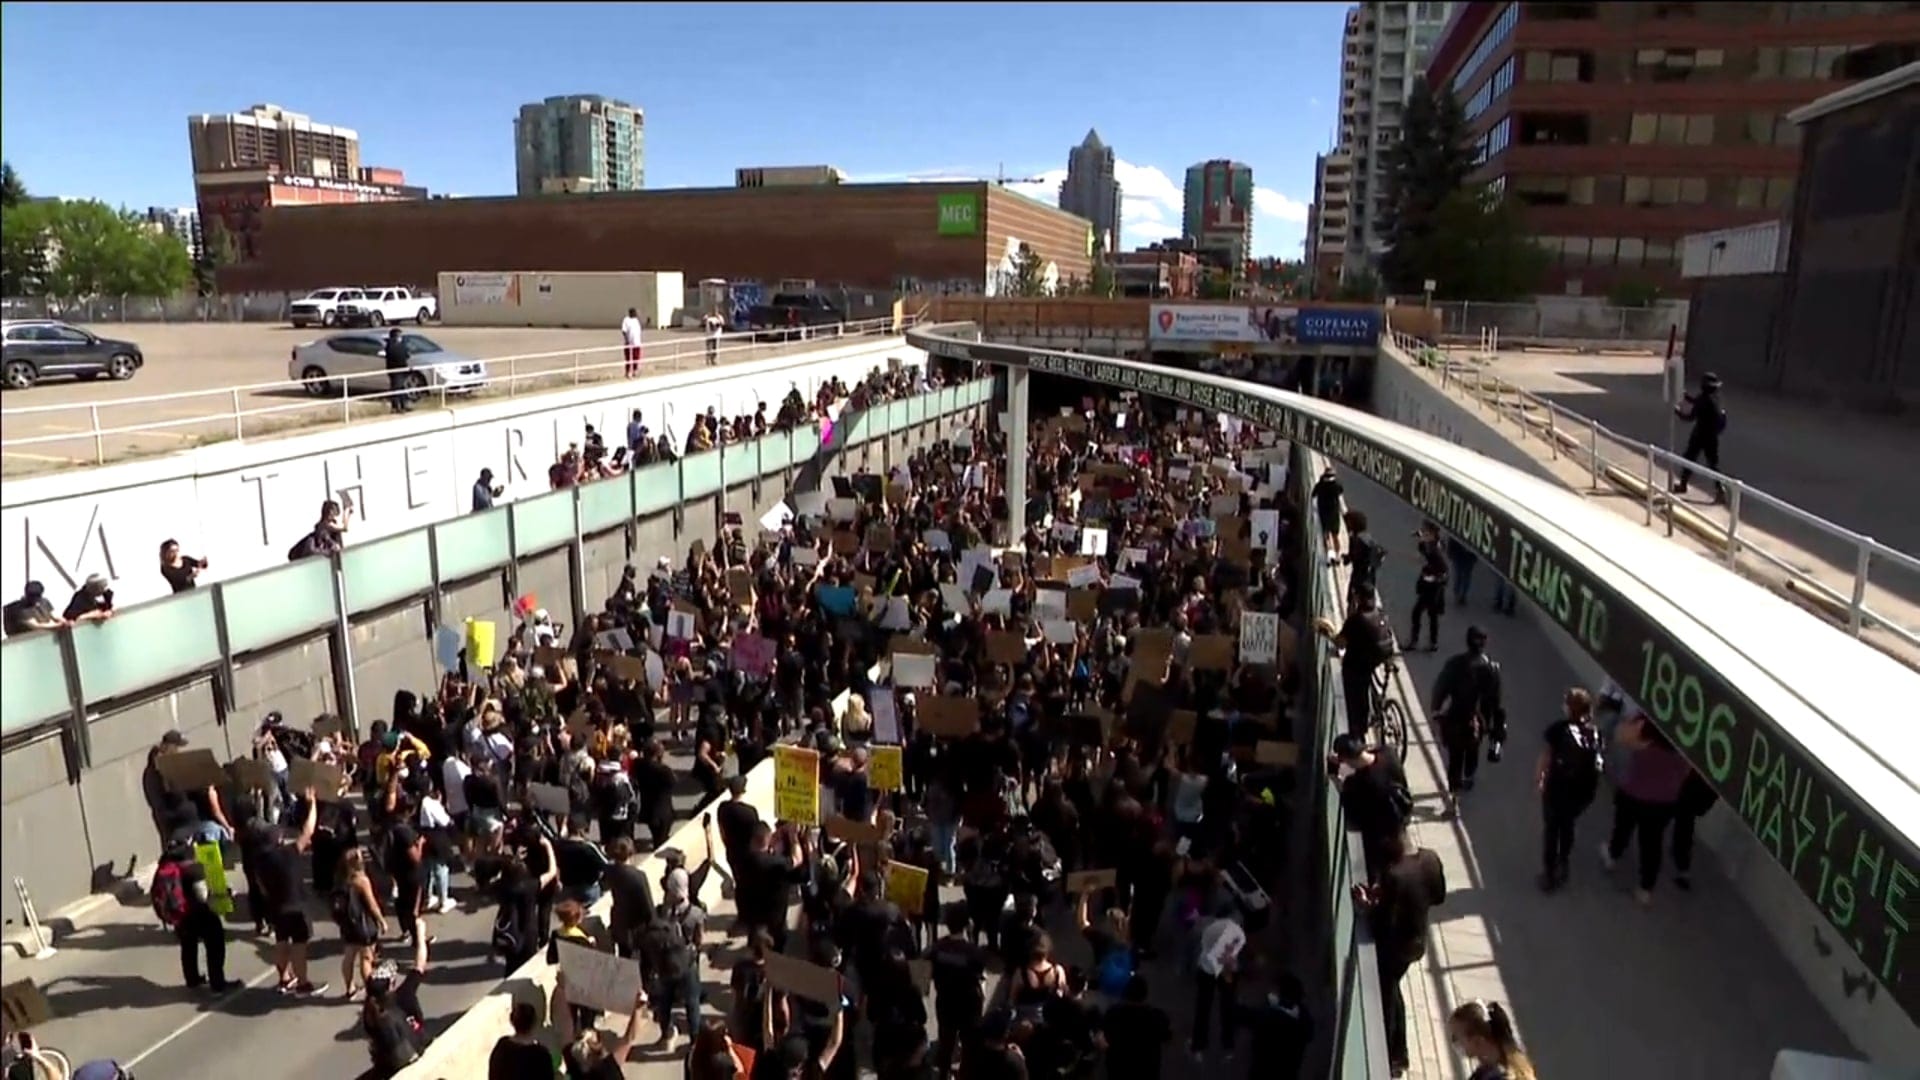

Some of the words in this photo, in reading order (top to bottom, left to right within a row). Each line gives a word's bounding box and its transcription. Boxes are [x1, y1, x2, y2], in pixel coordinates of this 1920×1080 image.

[942, 204, 972, 223] MEC
[1306, 318, 1369, 329] COPEMAN
[241, 445, 430, 546] THE
[1175, 380, 1192, 399] AND
[1192, 382, 1214, 408] HOSE
[1214, 386, 1237, 413] REEL
[1263, 403, 1283, 432] FOR
[1411, 469, 1499, 560] CONDITIONS:
[1510, 528, 1572, 622] TEAMS
[1578, 583, 1608, 651] TO
[1641, 639, 1737, 783] 1896
[1739, 770, 1814, 876] MAY
[1748, 728, 1847, 850] DAILY
